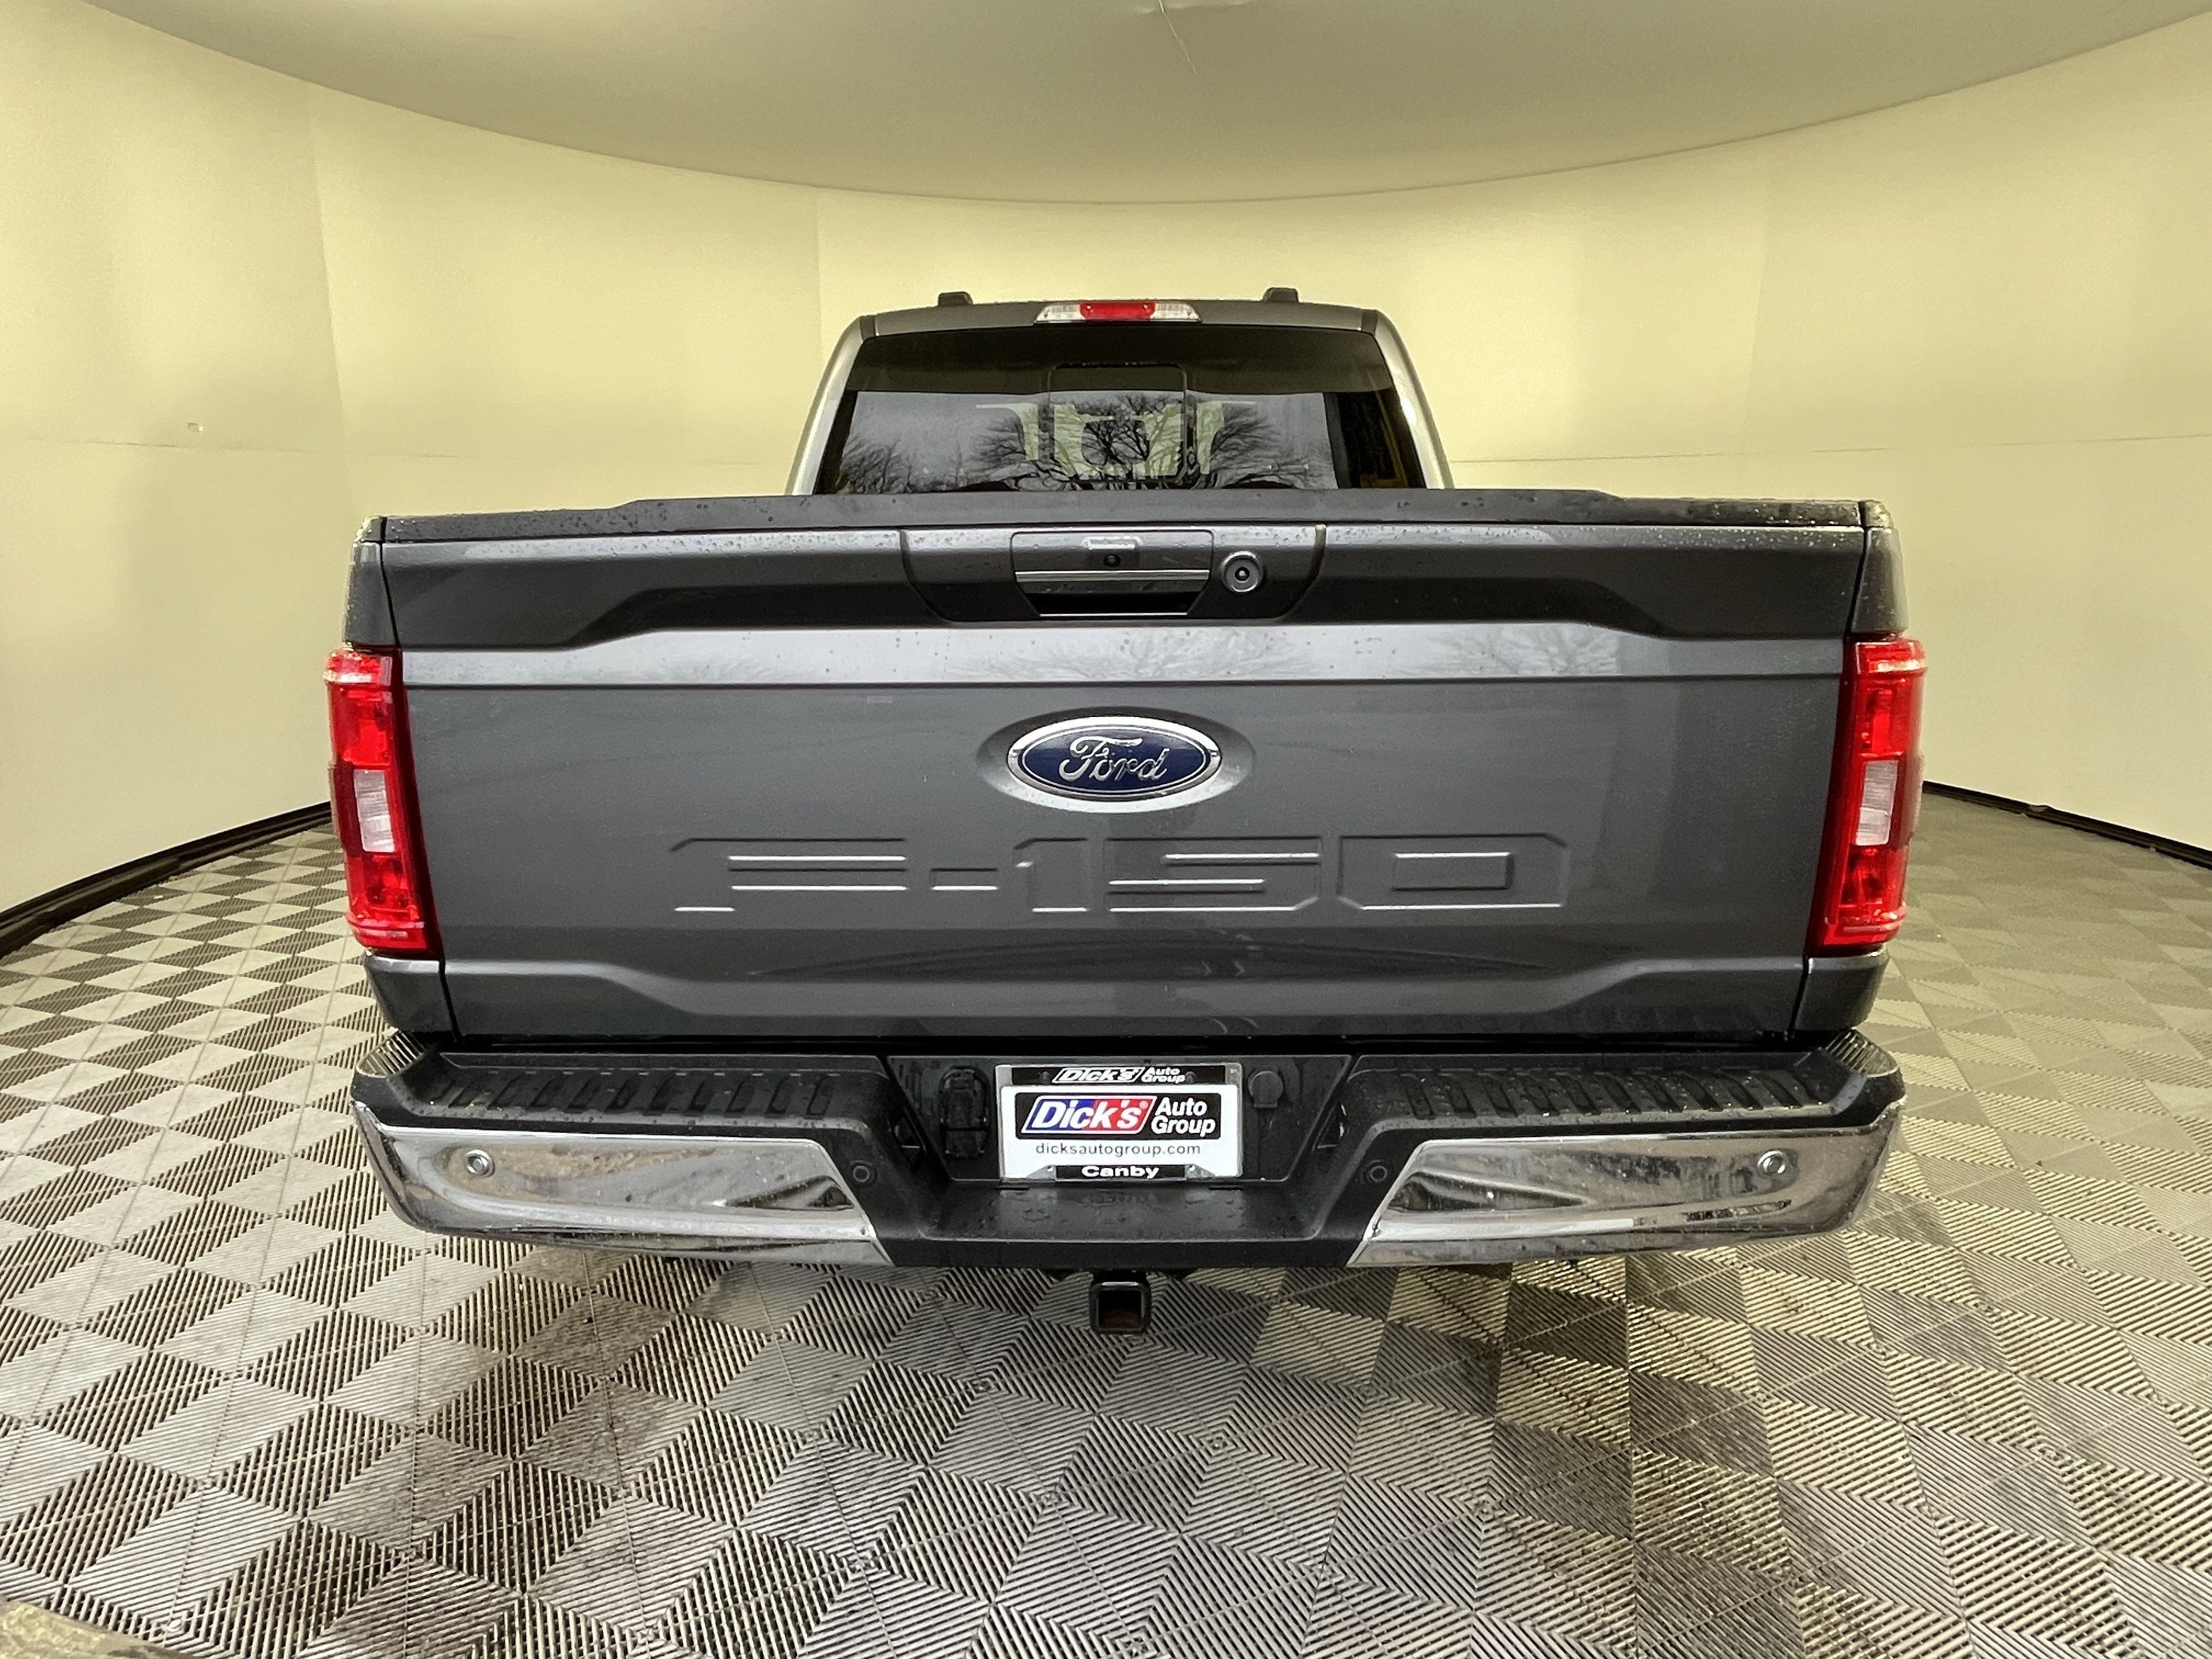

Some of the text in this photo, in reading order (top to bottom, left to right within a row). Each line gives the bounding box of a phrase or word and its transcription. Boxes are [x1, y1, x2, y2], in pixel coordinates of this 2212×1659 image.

[1059, 736, 1170, 782] Ford
[669, 835, 1570, 915] F-150
[1141, 1075, 1186, 1084] Group
[1146, 1066, 1181, 1076] Auto
[1031, 1099, 1144, 1129] Dick's
[1155, 1097, 1207, 1116] Auto
[1151, 1115, 1216, 1137] Group
[1036, 1143, 1200, 1157] dicksautogroup.com
[1081, 1165, 1159, 1178] Canby
